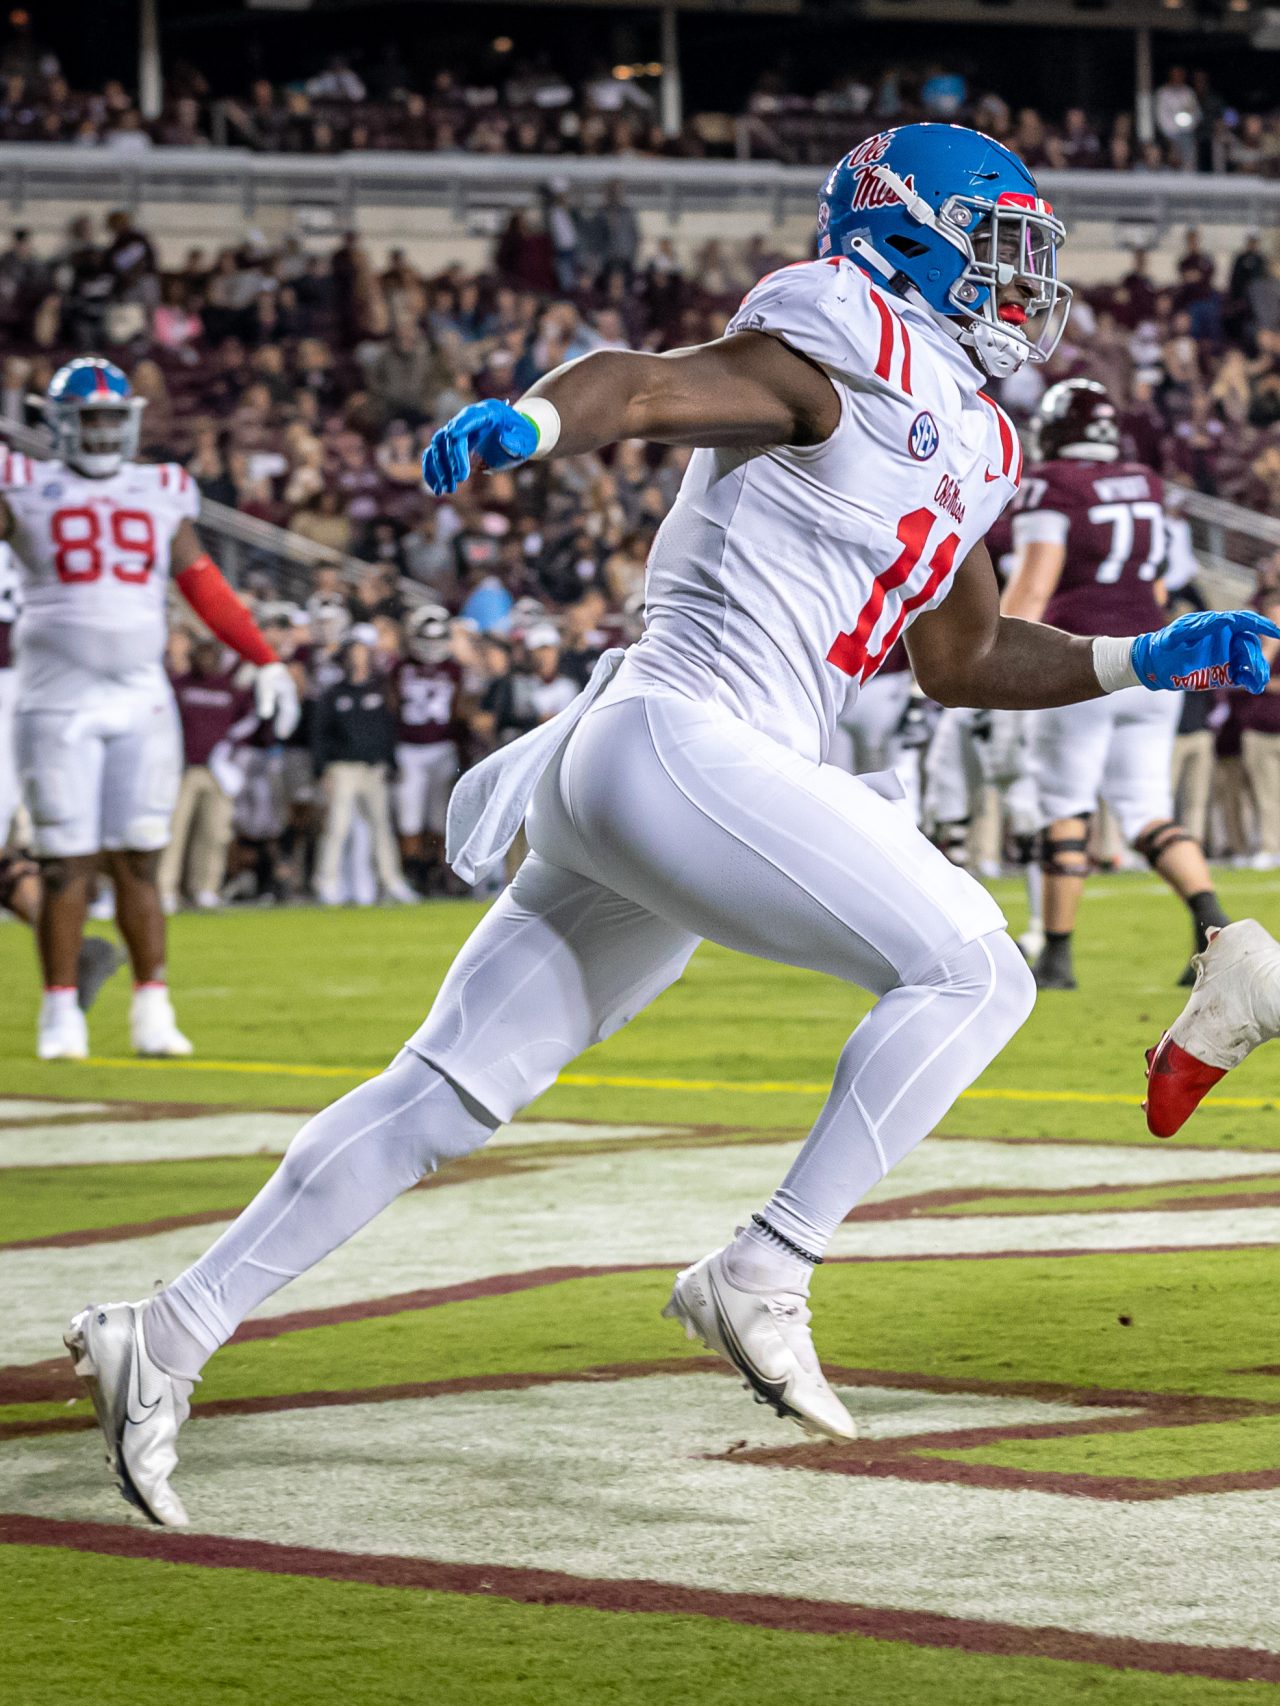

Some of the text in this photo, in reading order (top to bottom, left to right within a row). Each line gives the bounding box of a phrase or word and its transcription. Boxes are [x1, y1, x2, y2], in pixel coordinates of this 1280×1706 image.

[847, 131, 896, 168] Ole
[852, 163, 918, 212] Mis
[52, 506, 156, 585] 89
[1088, 501, 1165, 584] 77
[826, 506, 962, 690] 11
